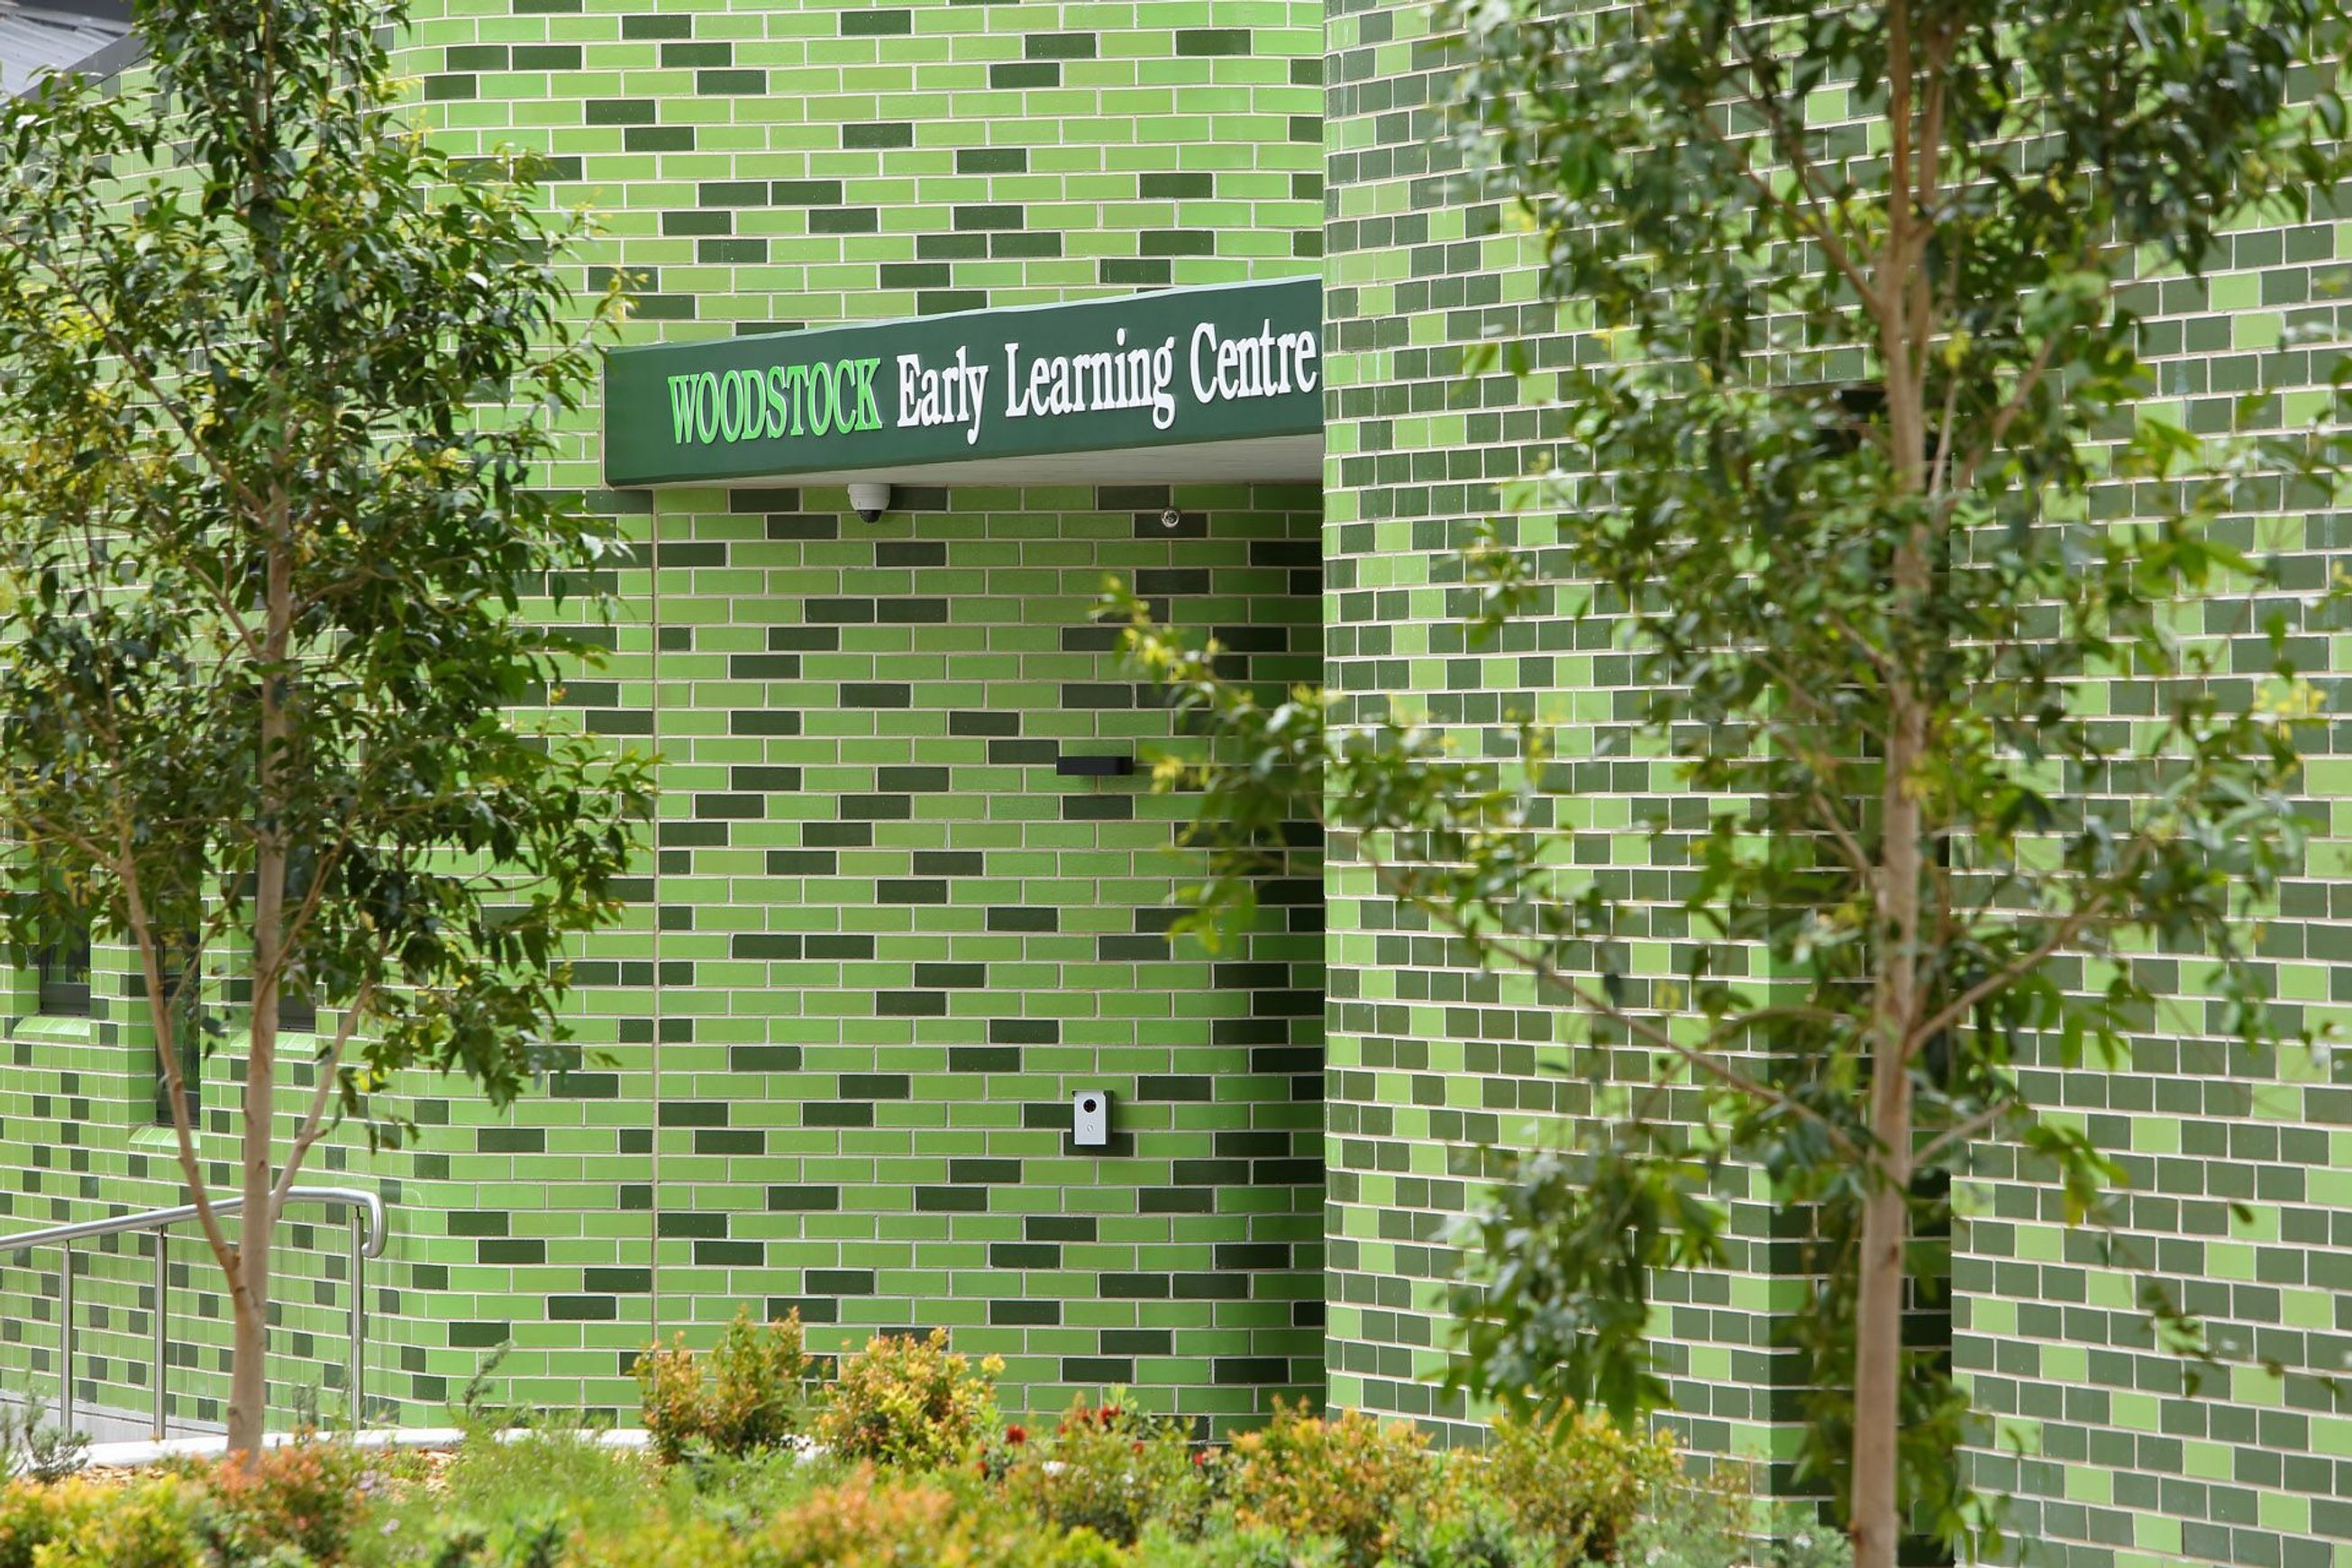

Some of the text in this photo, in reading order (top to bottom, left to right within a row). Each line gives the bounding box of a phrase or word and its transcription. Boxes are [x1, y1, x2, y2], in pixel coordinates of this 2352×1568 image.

[667, 318, 1319, 445] WOODSTOCK Early Learning Centre
